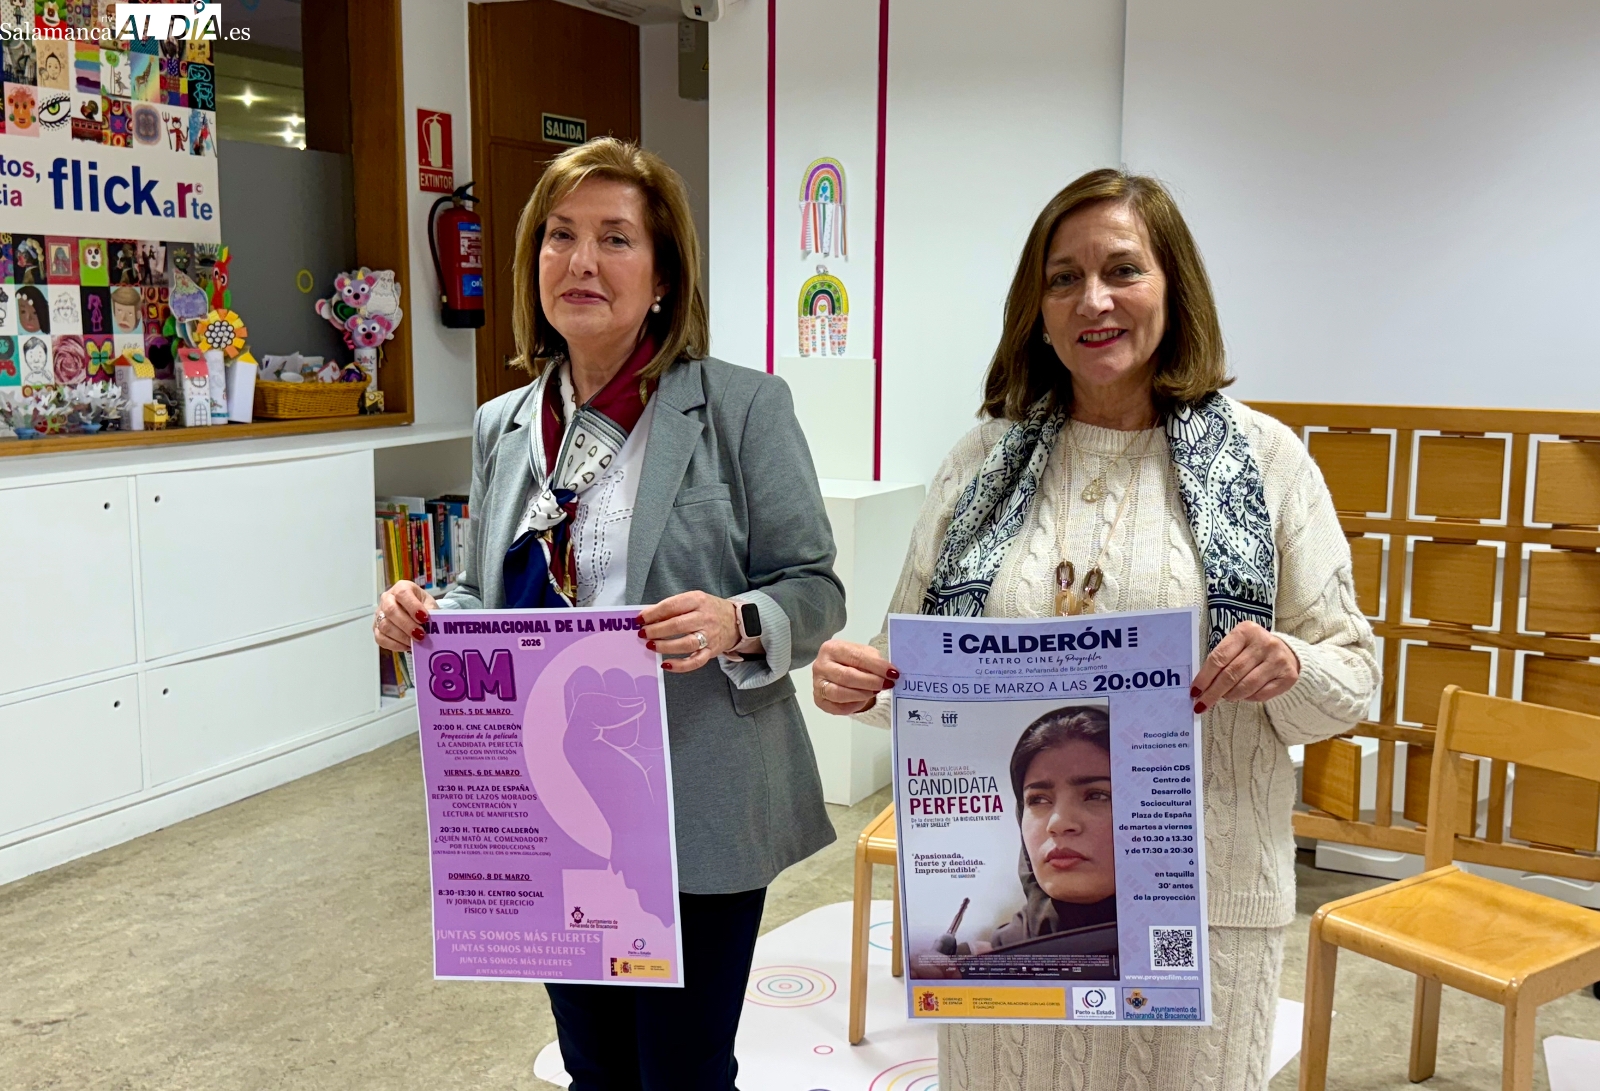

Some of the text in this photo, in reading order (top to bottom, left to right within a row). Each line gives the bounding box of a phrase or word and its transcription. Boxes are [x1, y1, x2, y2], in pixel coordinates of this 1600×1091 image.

[546, 119, 583, 141] SALIDA
[420, 172, 453, 190] EXTINTOR
[443, 619, 551, 635] INTERNACIONAL
[555, 619, 574, 633] DE
[577, 619, 595, 632] LA
[599, 617, 642, 631] MUJE
[521, 638, 541, 647] 2026
[958, 626, 1123, 654] CALDERÓN
[978, 656, 1021, 665] TEATRO
[1026, 655, 1053, 664] CINE
[1056, 655, 1063, 666] by
[428, 648, 517, 701] 8M
[984, 667, 1017, 675] Cerrajeros
[1025, 666, 1059, 674] Peñaranda
[1060, 665, 1068, 673] de
[1069, 664, 1108, 672] Bracamonte
[902, 669, 1181, 695] JUEVES 05 DE MARZO A LAS 20:00h
[941, 713, 958, 724] tiff
[484, 722, 522, 731] CALDERÓN
[440, 732, 475, 740] Proyección
[1144, 731, 1178, 739] Recogida
[907, 758, 928, 777] LA
[1132, 765, 1172, 773] Recepción
[503, 784, 530, 792] ESPAÑA
[908, 776, 998, 796] CANDIDATA
[910, 795, 1003, 815] PERFECTA
[501, 826, 539, 834] CALDERÓN
[436, 930, 600, 943] JUNTAS SOMOS MÁS FUERTES
[451, 944, 586, 955] JUNTAS SOMOS MÁS FUERTES
[459, 956, 572, 966] JUNTAS SOMOS MÁS FUERTES
